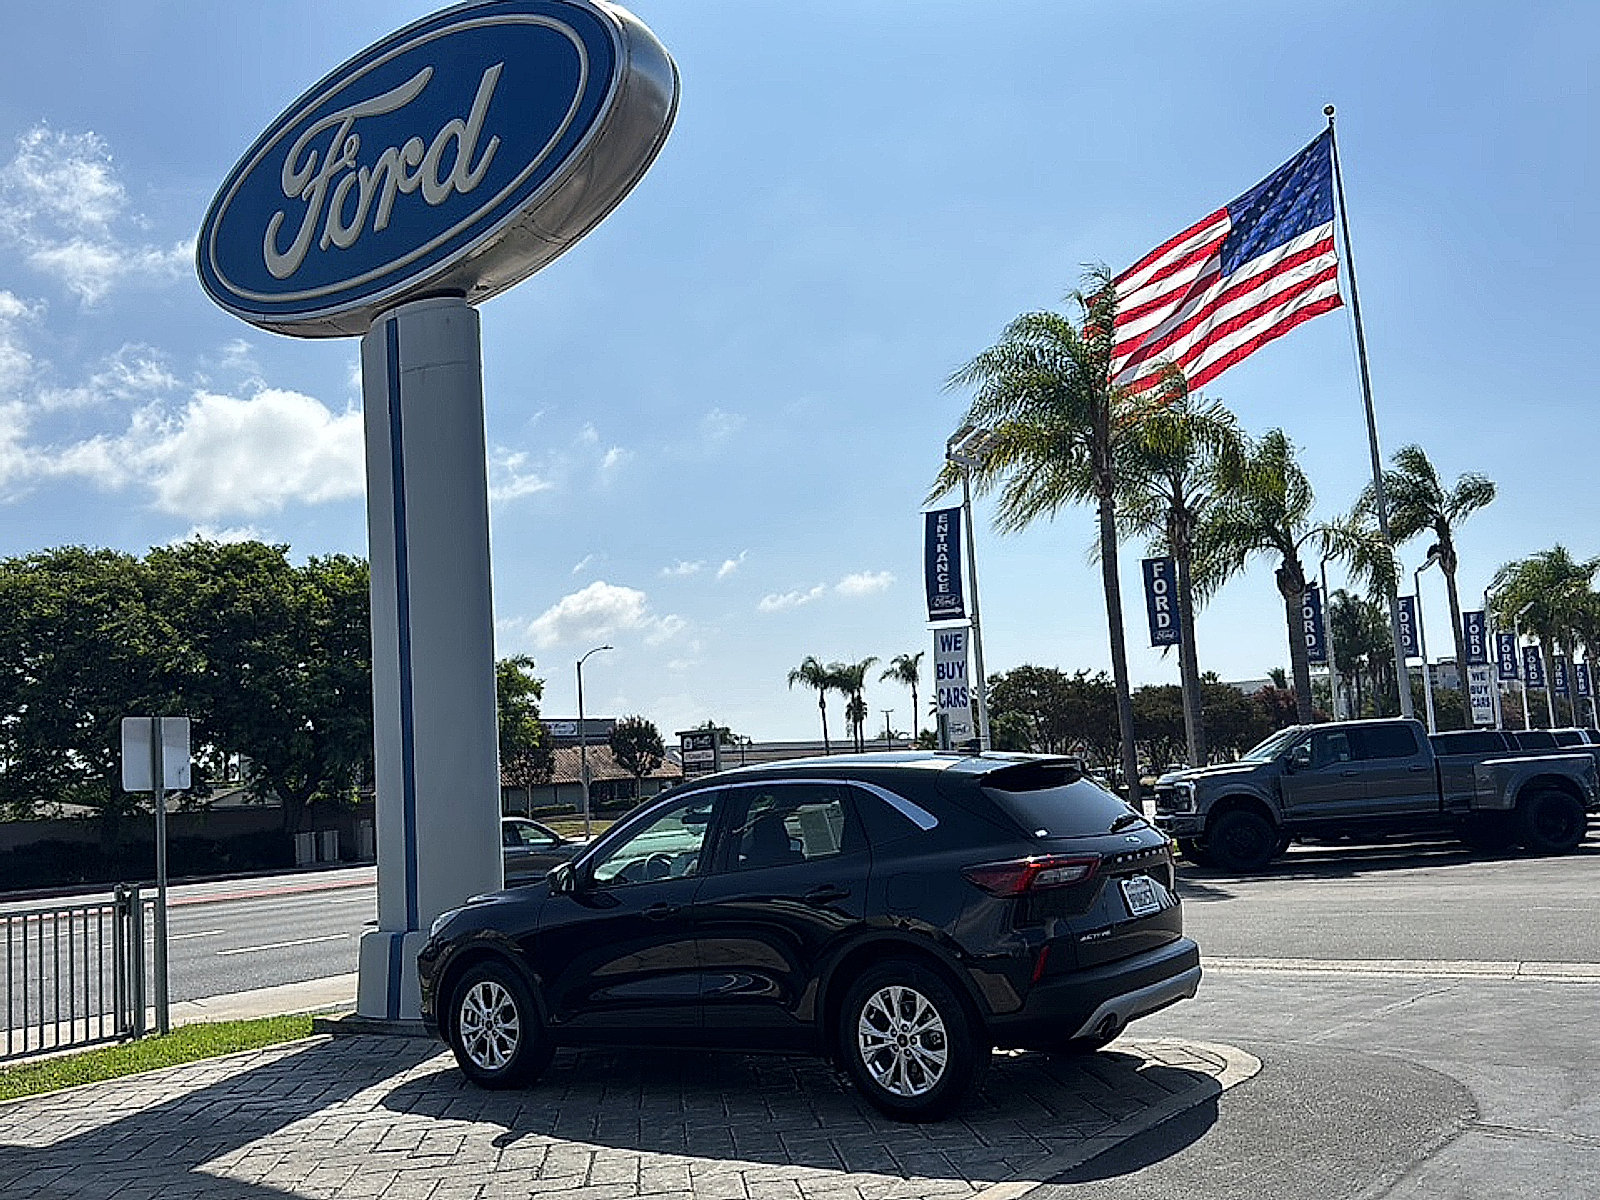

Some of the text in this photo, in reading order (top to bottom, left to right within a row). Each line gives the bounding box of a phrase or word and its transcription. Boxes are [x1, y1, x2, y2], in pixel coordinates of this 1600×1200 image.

[264, 61, 504, 280] Ford
[936, 513, 950, 593] ENTRANCE
[1152, 562, 1170, 628] FORD
[1302, 592, 1316, 647] FORD
[1398, 600, 1411, 646] FORD
[1469, 614, 1481, 655] FORD
[940, 633, 962, 652] WE
[1501, 635, 1513, 671] FORD
[937, 661, 965, 680] BUY
[939, 687, 968, 709] CARS
